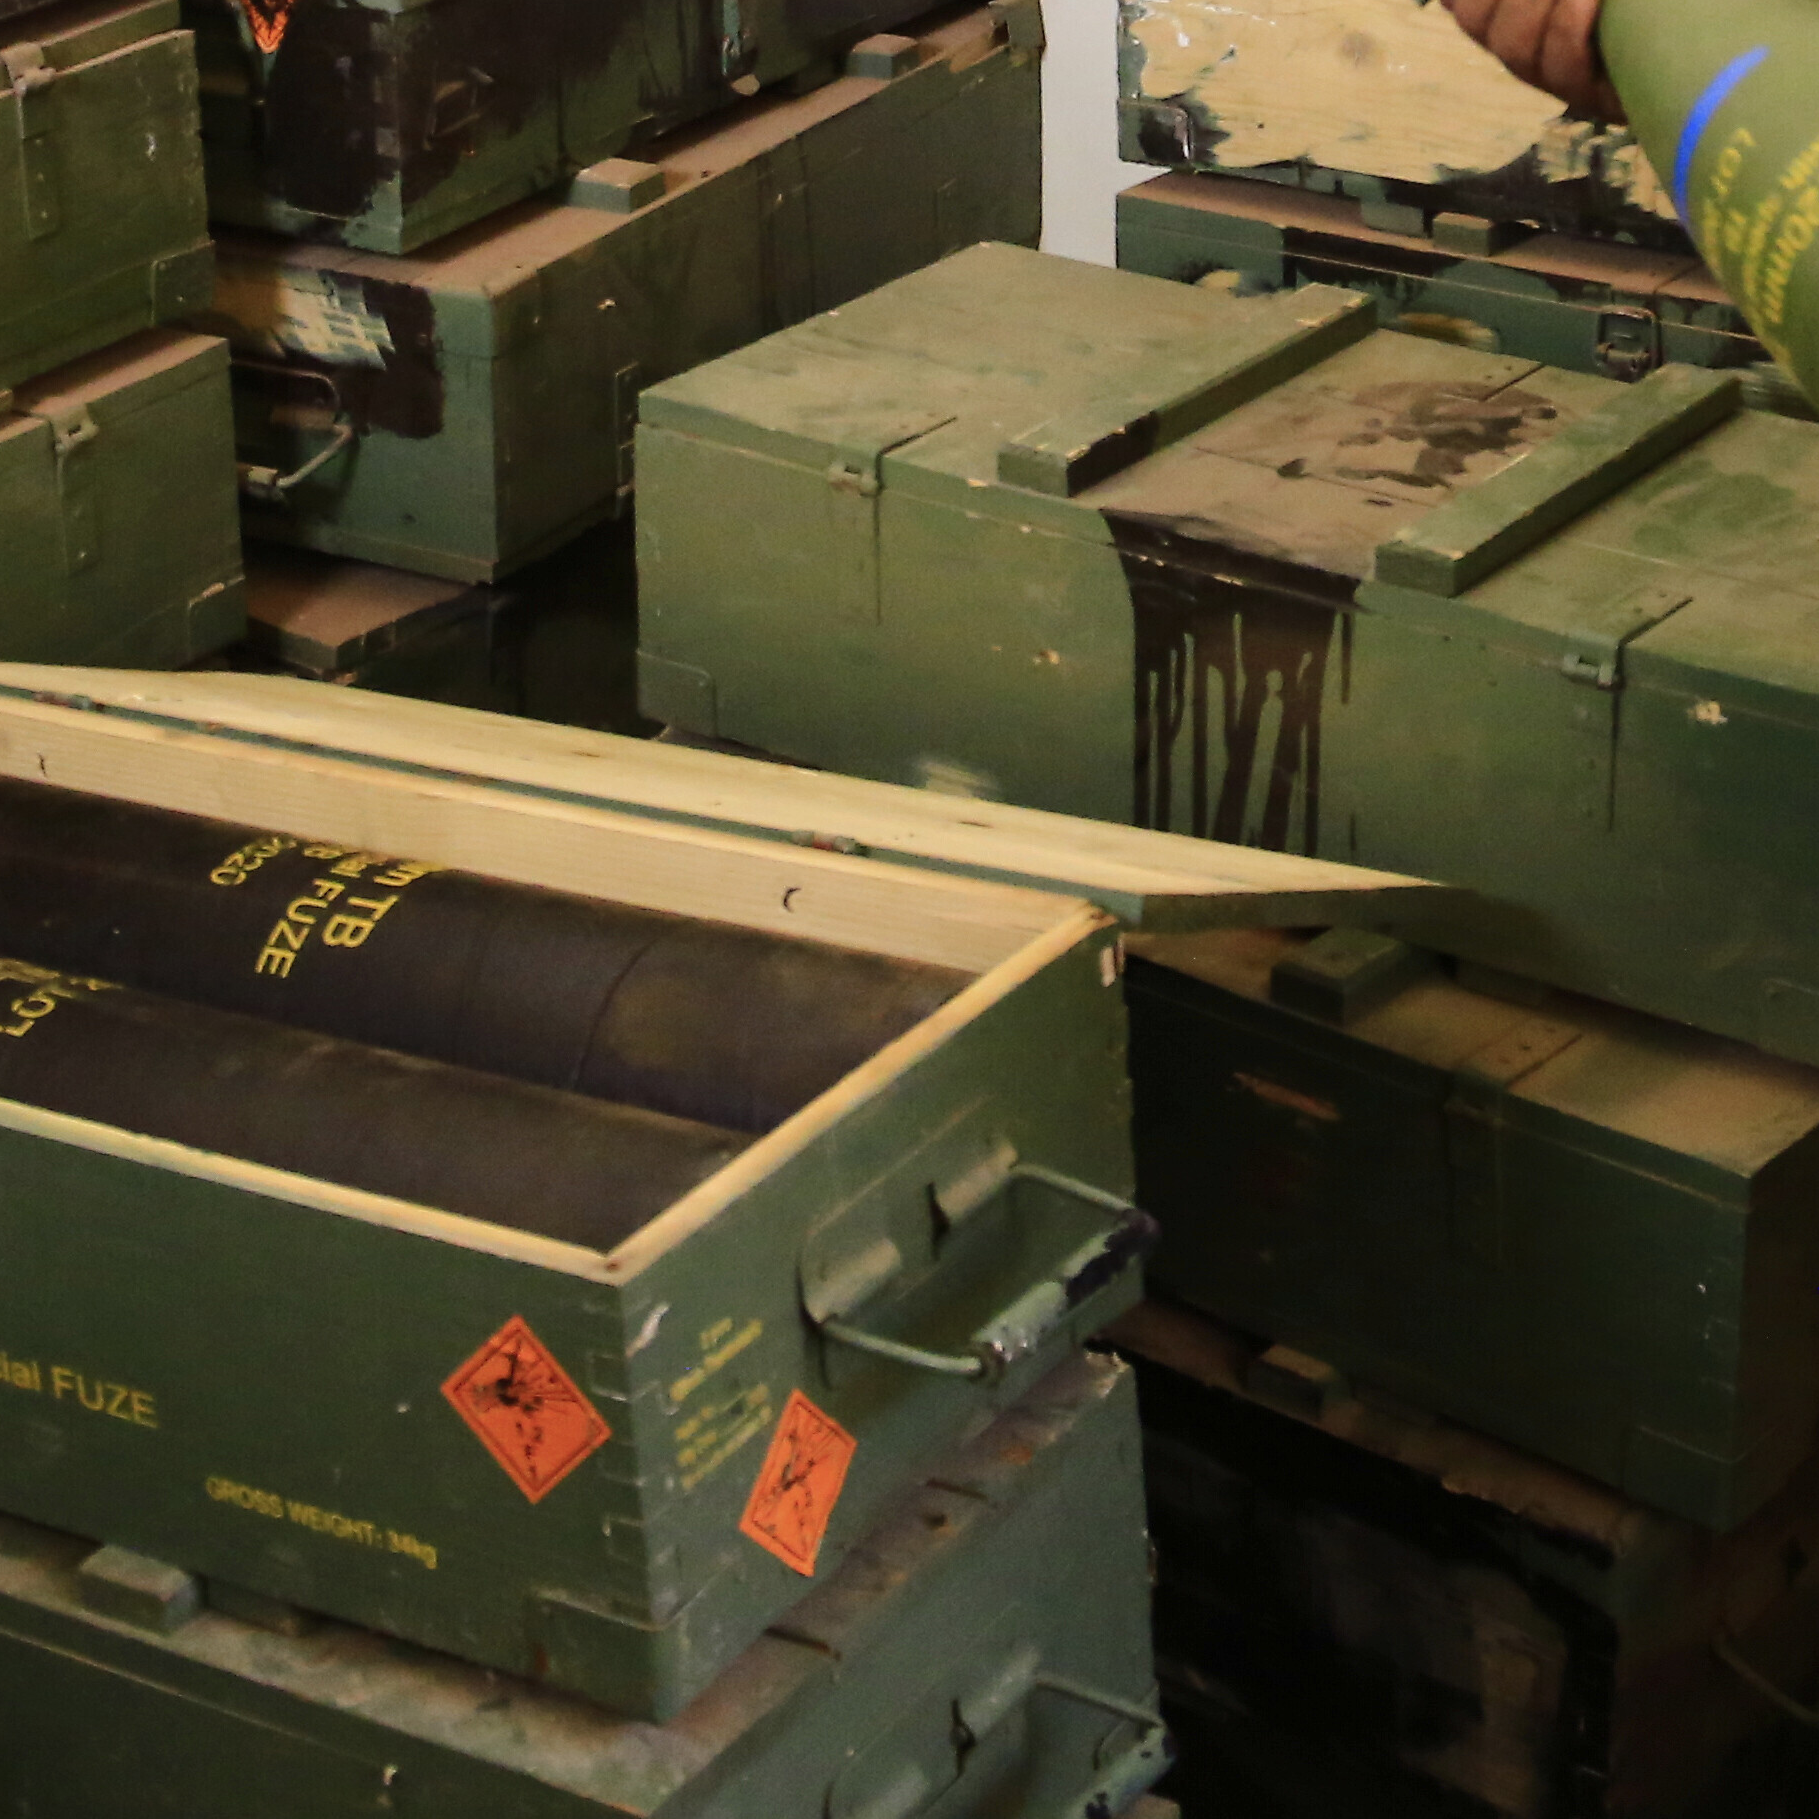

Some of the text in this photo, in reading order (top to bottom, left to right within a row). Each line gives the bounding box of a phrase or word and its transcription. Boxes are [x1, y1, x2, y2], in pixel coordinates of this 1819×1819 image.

[253, 877, 347, 979] FUZE
[321, 893, 401, 949] TB
[51, 1365, 160, 1430] FUZE
